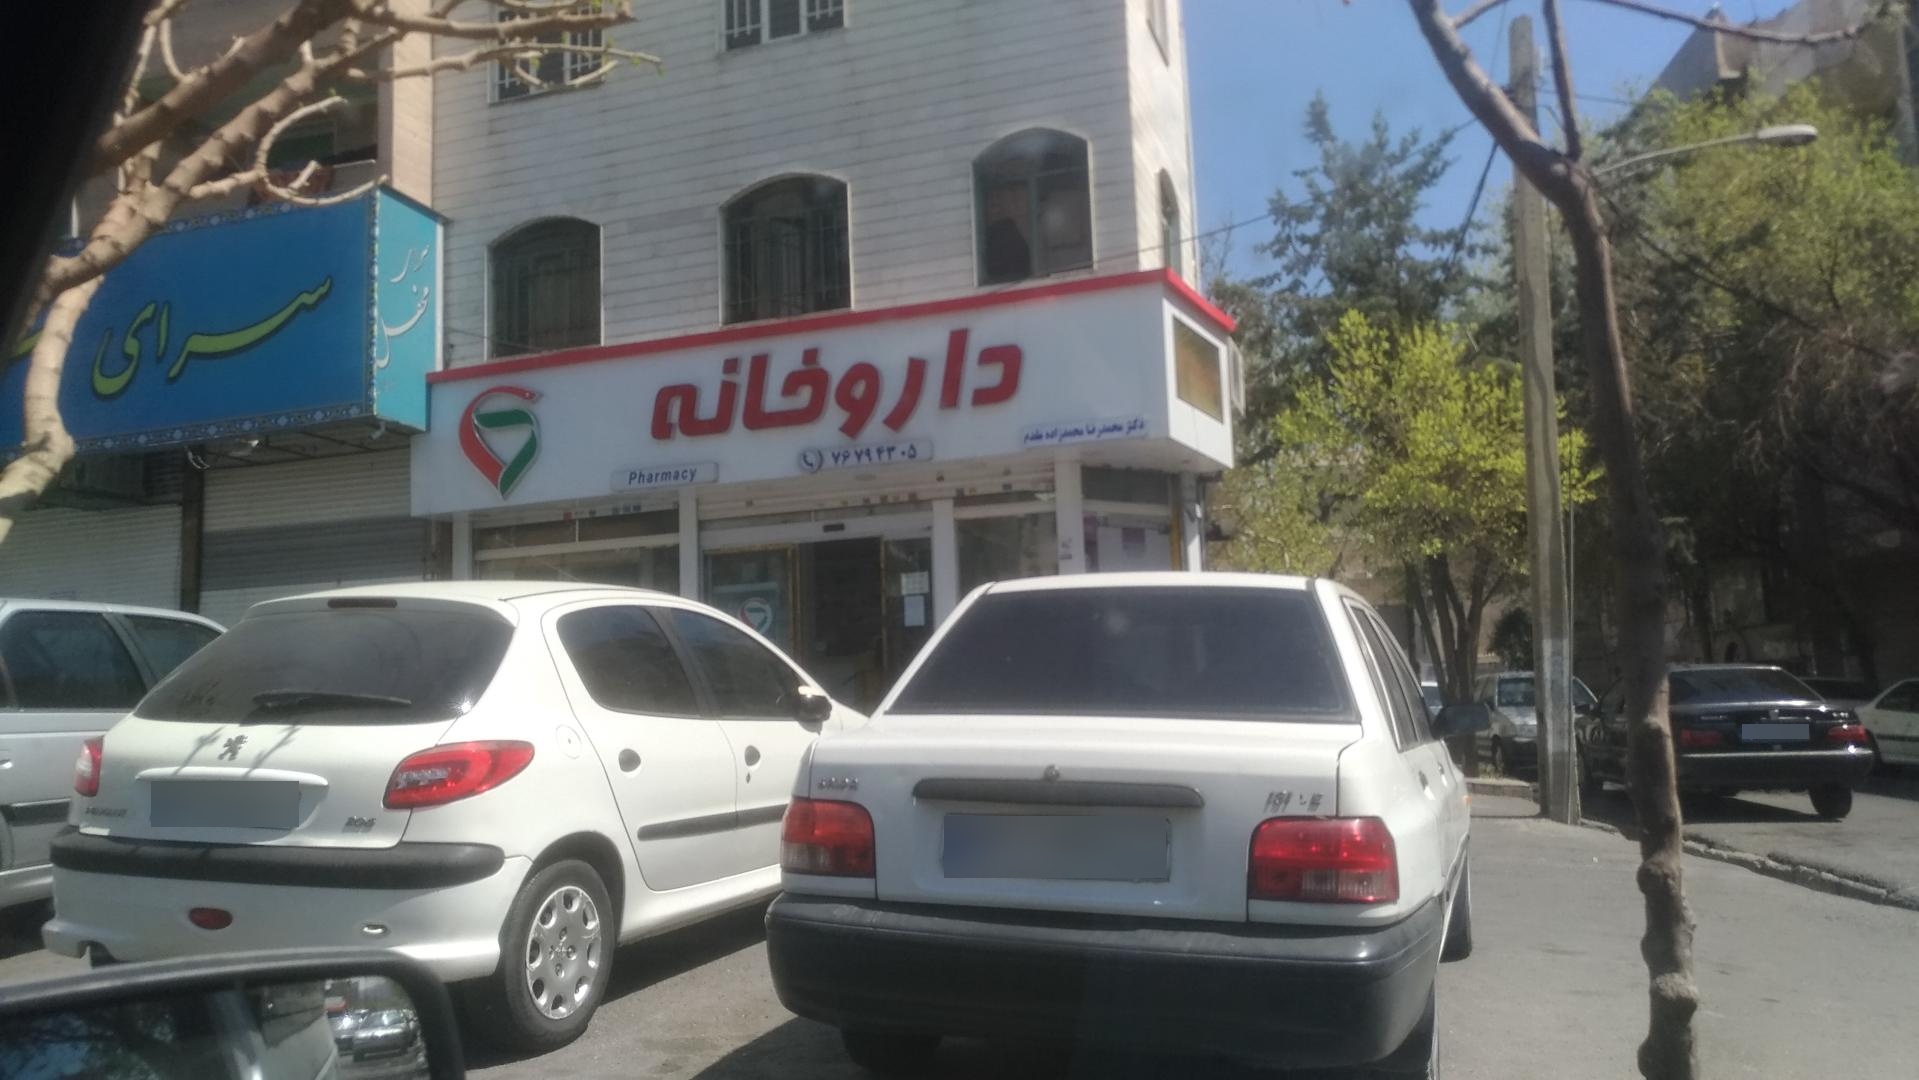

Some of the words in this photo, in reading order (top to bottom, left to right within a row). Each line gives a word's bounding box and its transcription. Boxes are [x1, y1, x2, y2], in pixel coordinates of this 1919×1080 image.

[91, 275, 333, 401] سرای
[651, 328, 1022, 440] داروخانه
[627, 467, 697, 485] Pharmacy
